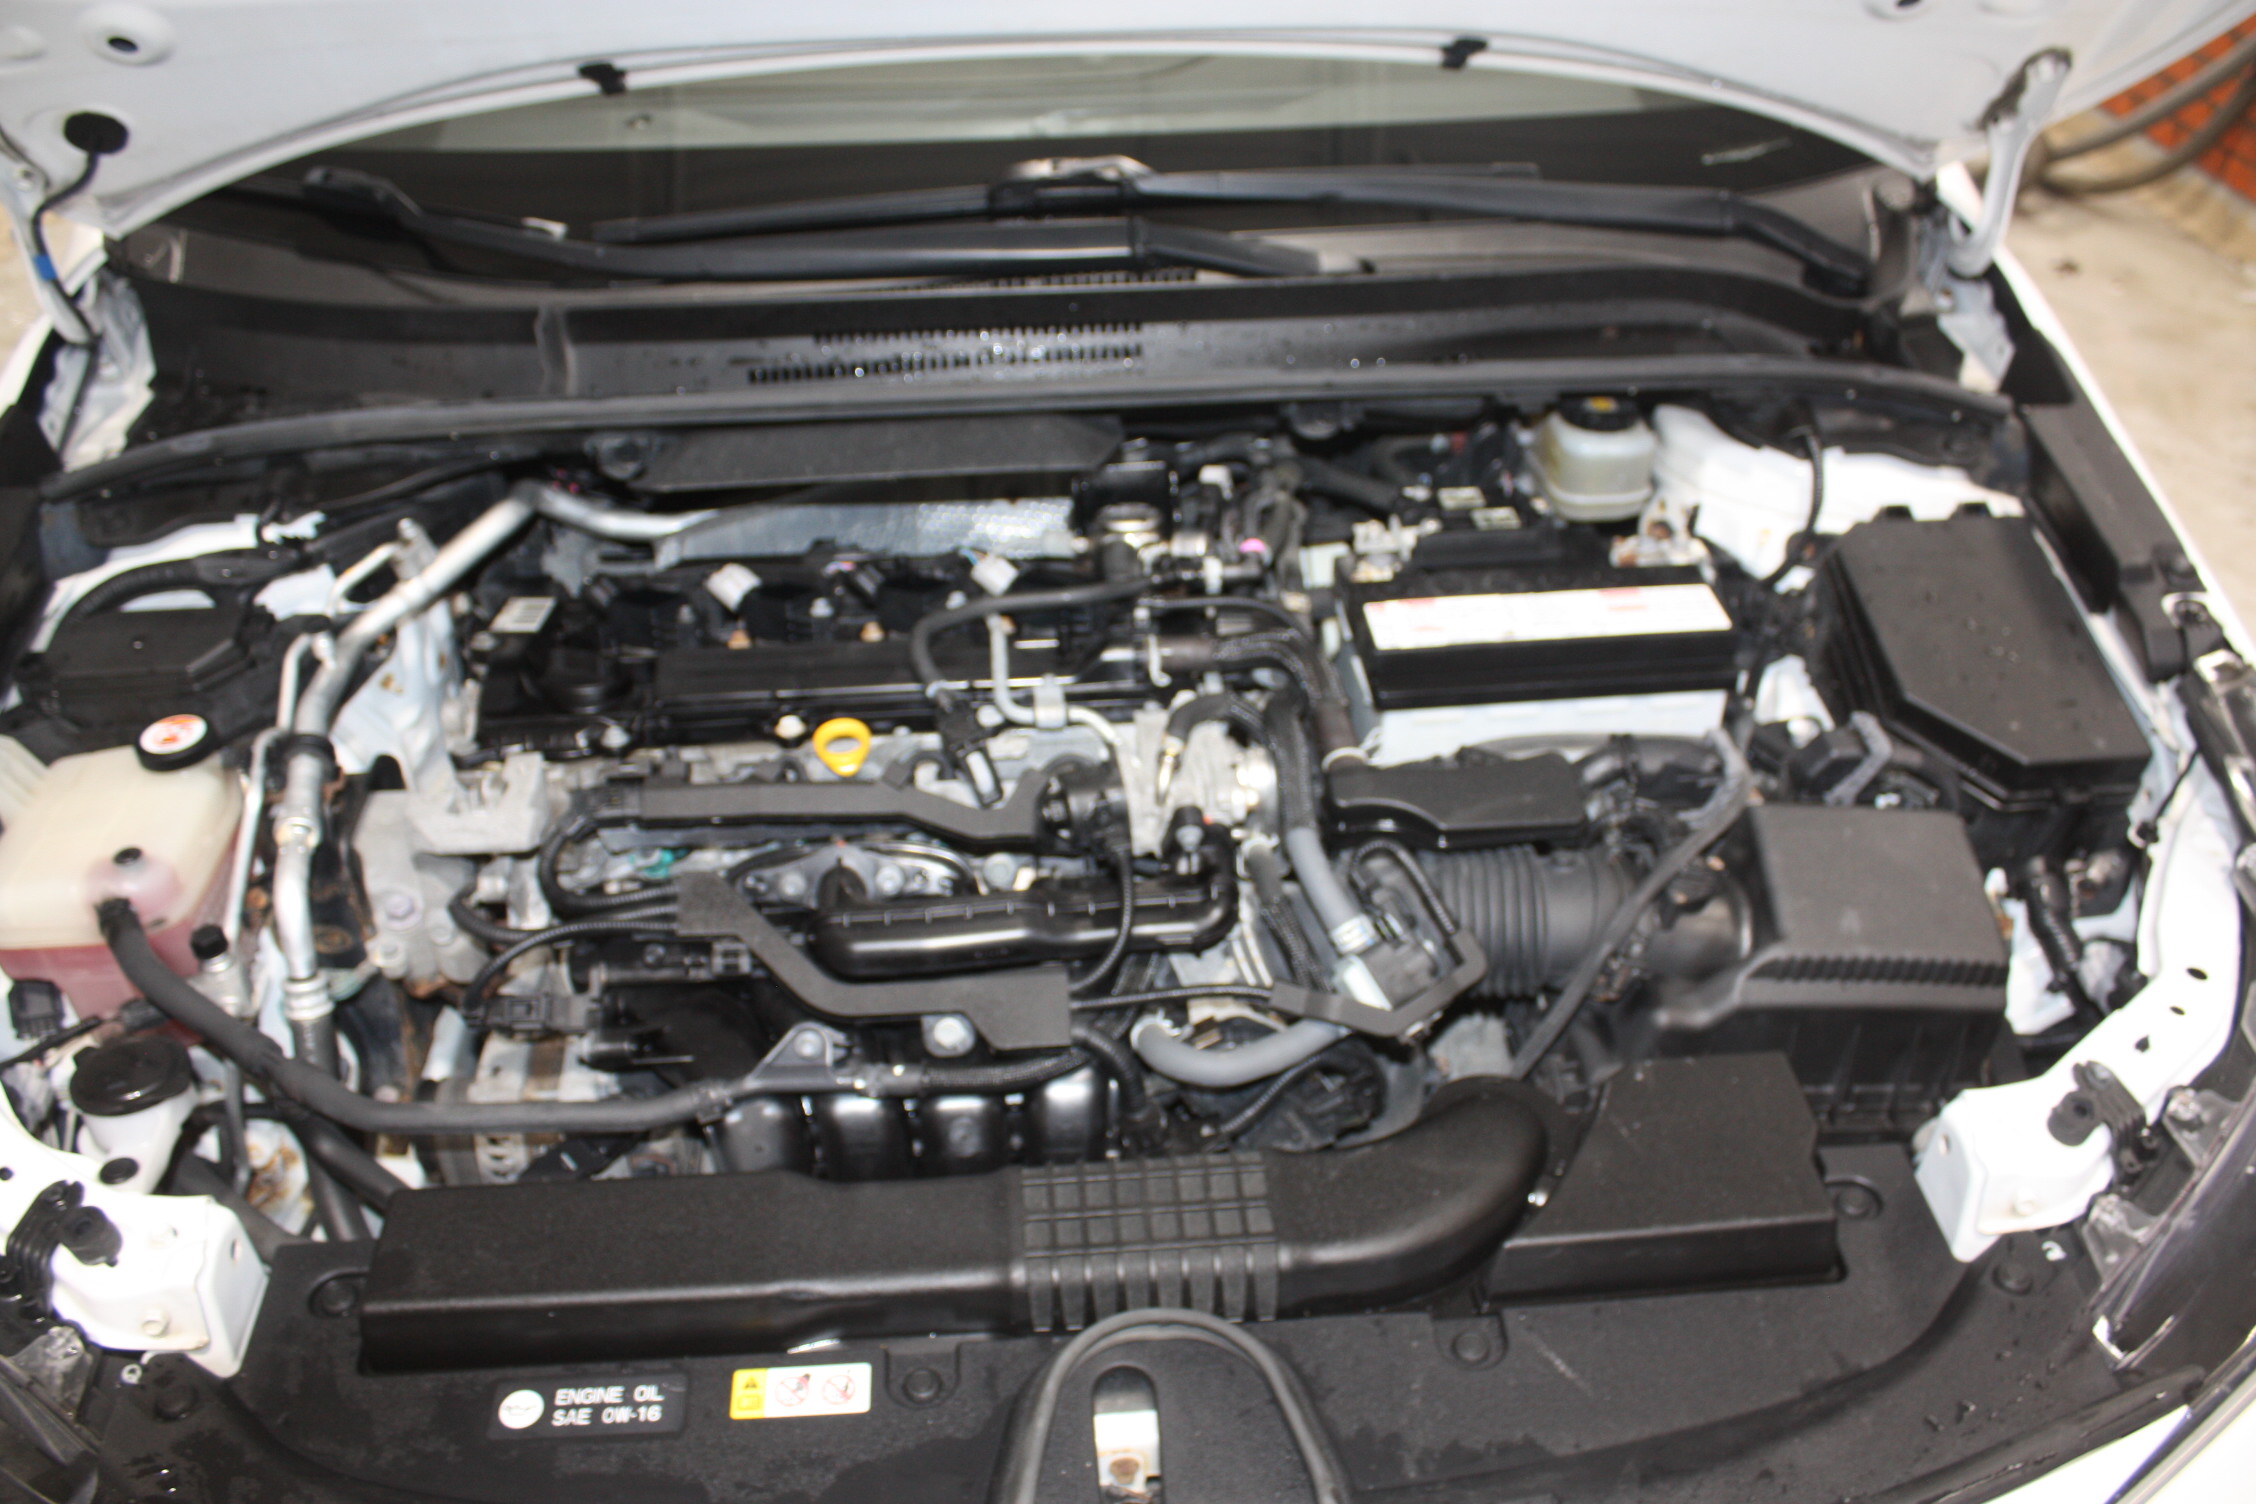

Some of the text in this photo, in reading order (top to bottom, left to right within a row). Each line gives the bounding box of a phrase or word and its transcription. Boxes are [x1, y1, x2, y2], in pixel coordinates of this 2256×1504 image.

[554, 1384, 665, 1406] ENGINE OIL
[551, 1405, 662, 1426] SAE 0W-16
